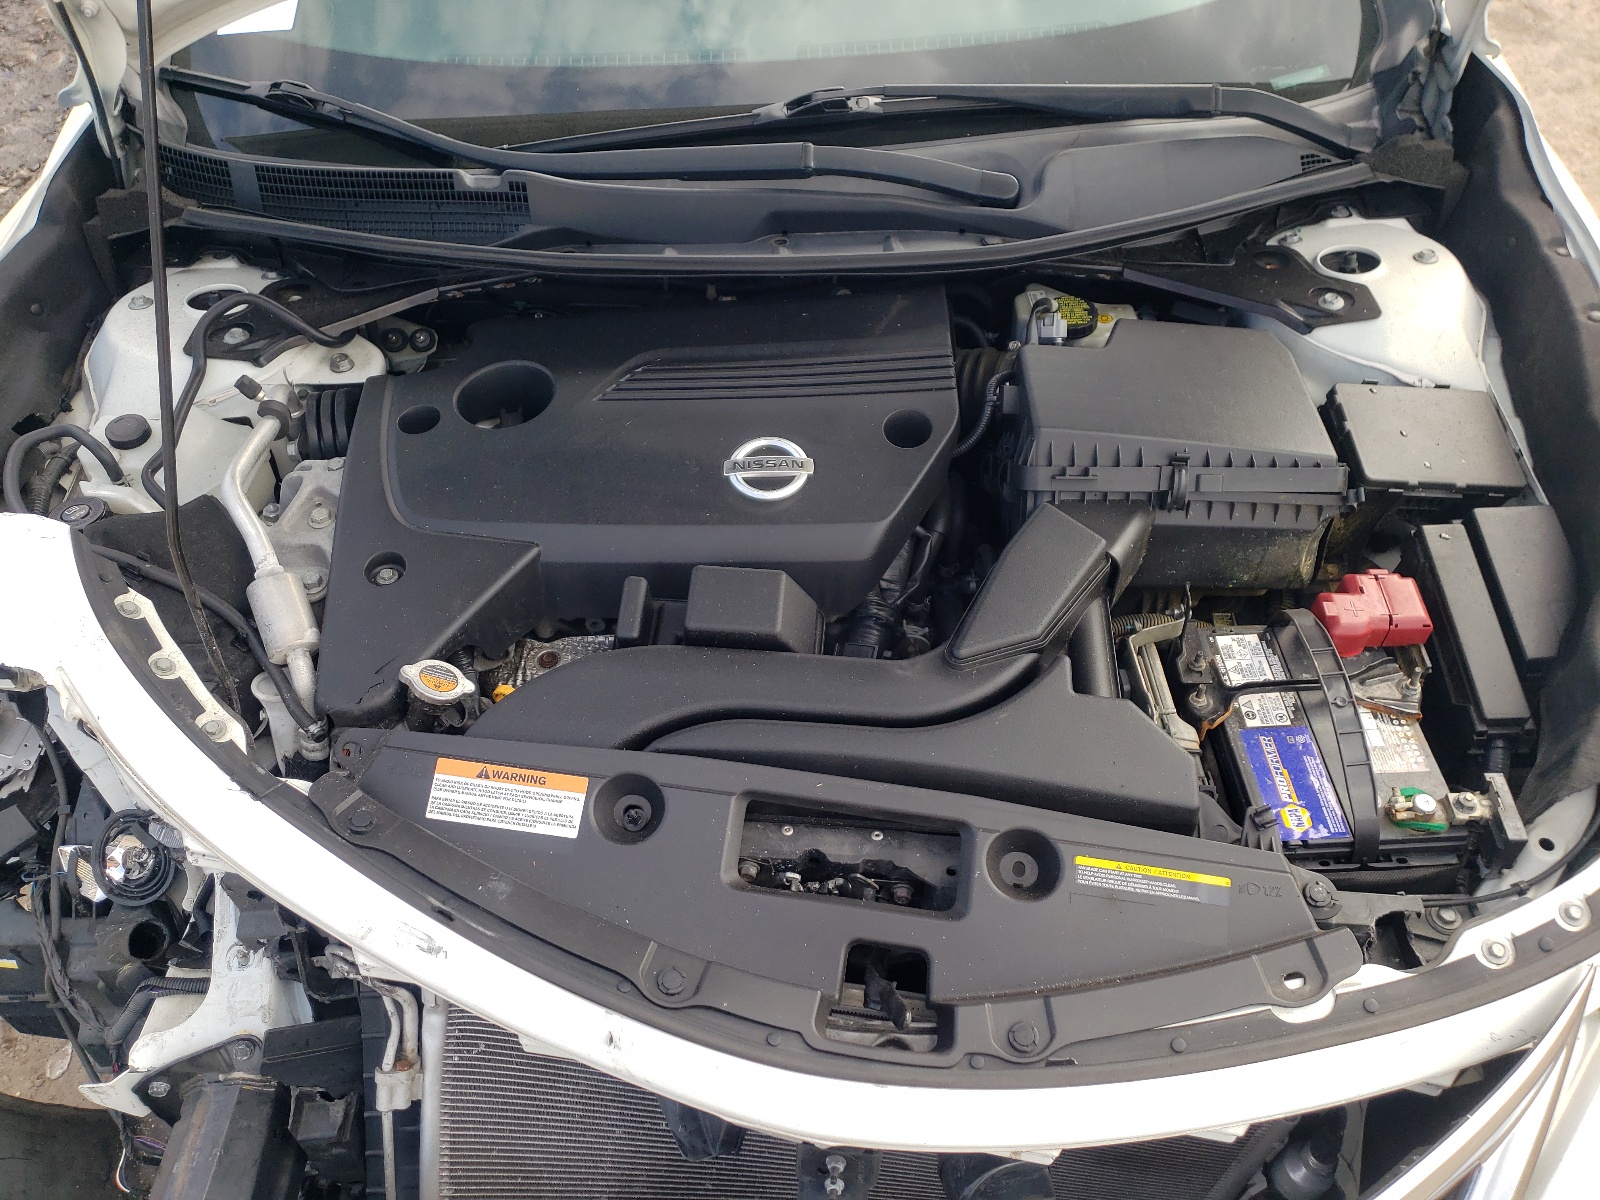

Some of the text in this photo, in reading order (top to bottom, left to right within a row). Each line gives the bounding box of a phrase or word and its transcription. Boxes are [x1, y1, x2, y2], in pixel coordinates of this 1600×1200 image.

[732, 460, 804, 470] NISSAN
[1261, 736, 1294, 802] PROFORMER
[492, 770, 546, 785] WARNING
[1287, 809, 1305, 827] NAPA
[1158, 871, 1190, 879] ATTENTION
